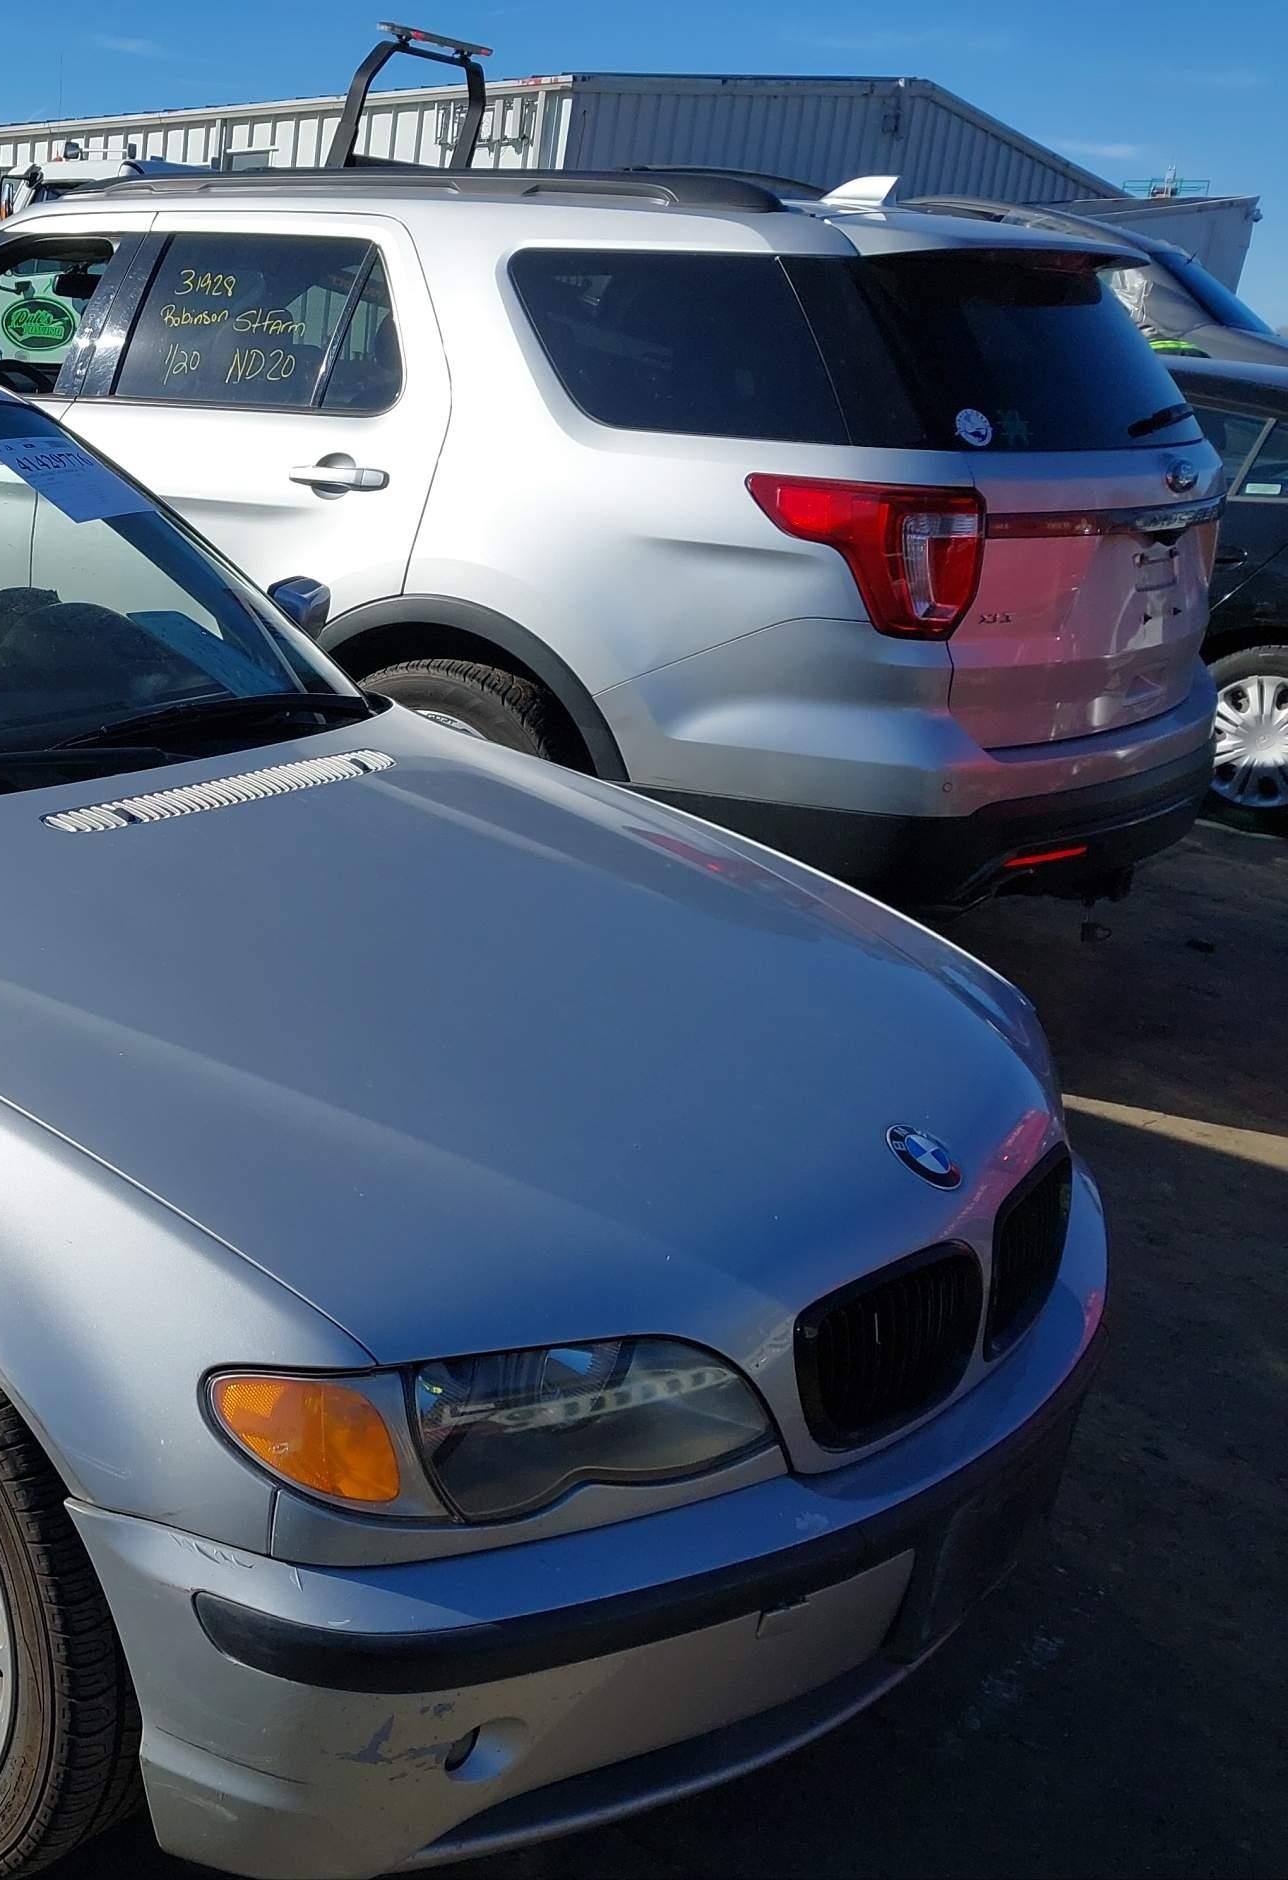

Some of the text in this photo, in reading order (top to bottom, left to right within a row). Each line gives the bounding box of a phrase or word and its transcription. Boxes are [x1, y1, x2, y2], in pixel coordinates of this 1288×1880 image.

[174, 269, 236, 298] 31928
[160, 304, 229, 327] Robinson
[163, 343, 201, 386] 1/20
[15, 452, 95, 472] 41429776
